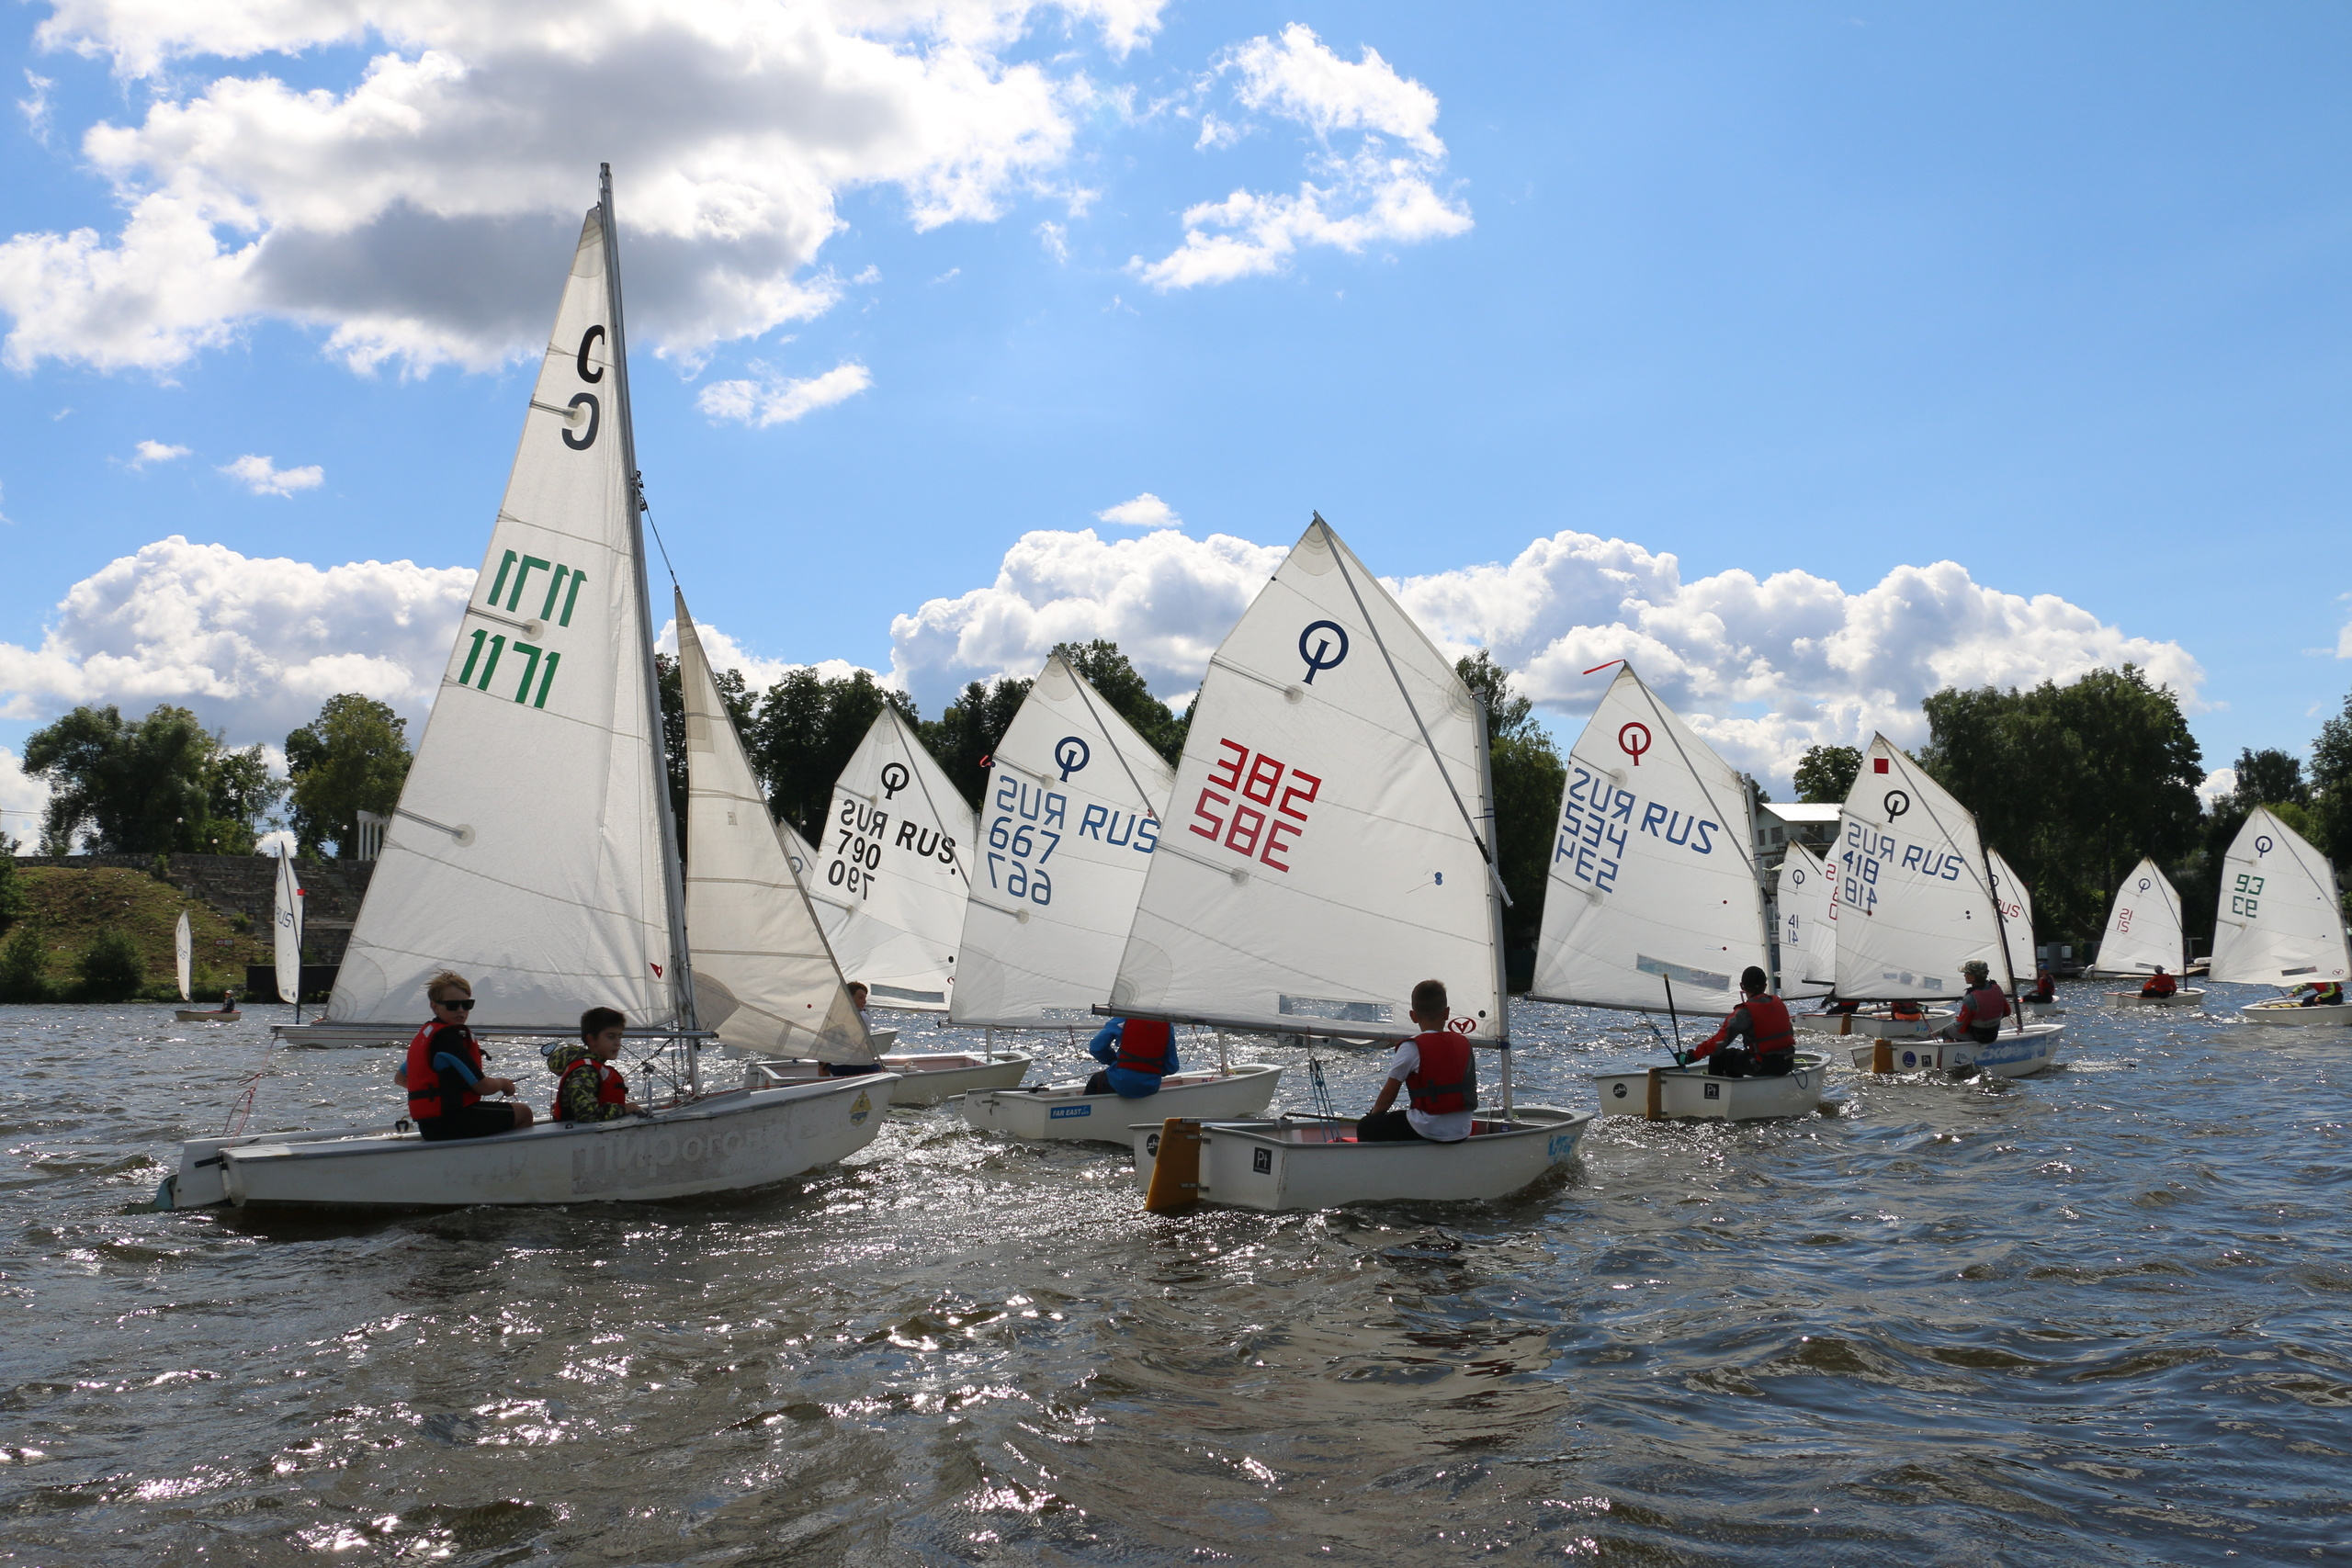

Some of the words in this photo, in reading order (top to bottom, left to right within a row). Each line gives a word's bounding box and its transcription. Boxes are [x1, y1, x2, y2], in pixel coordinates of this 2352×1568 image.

[577, 324, 605, 384] C
[458, 628, 561, 709] 1171
[1207, 738, 1322, 822] 382
[896, 820, 956, 864] RUS
[989, 816, 1060, 864] 667
[1079, 804, 1160, 854] RUS
[1563, 800, 1628, 859] 534
[1640, 801, 1719, 854] RUS
[836, 829, 881, 870] 790
[1843, 851, 1879, 885] 418
[1901, 844, 1963, 881] RUS
[2234, 874, 2265, 896] 93
[1788, 914, 1799, 929] 41
[2119, 908, 2133, 920] 21
[1707, 1086, 1717, 1096] Pt
[1066, 1108, 1081, 1116] EAST
[1256, 1150, 1269, 1168] Pt
